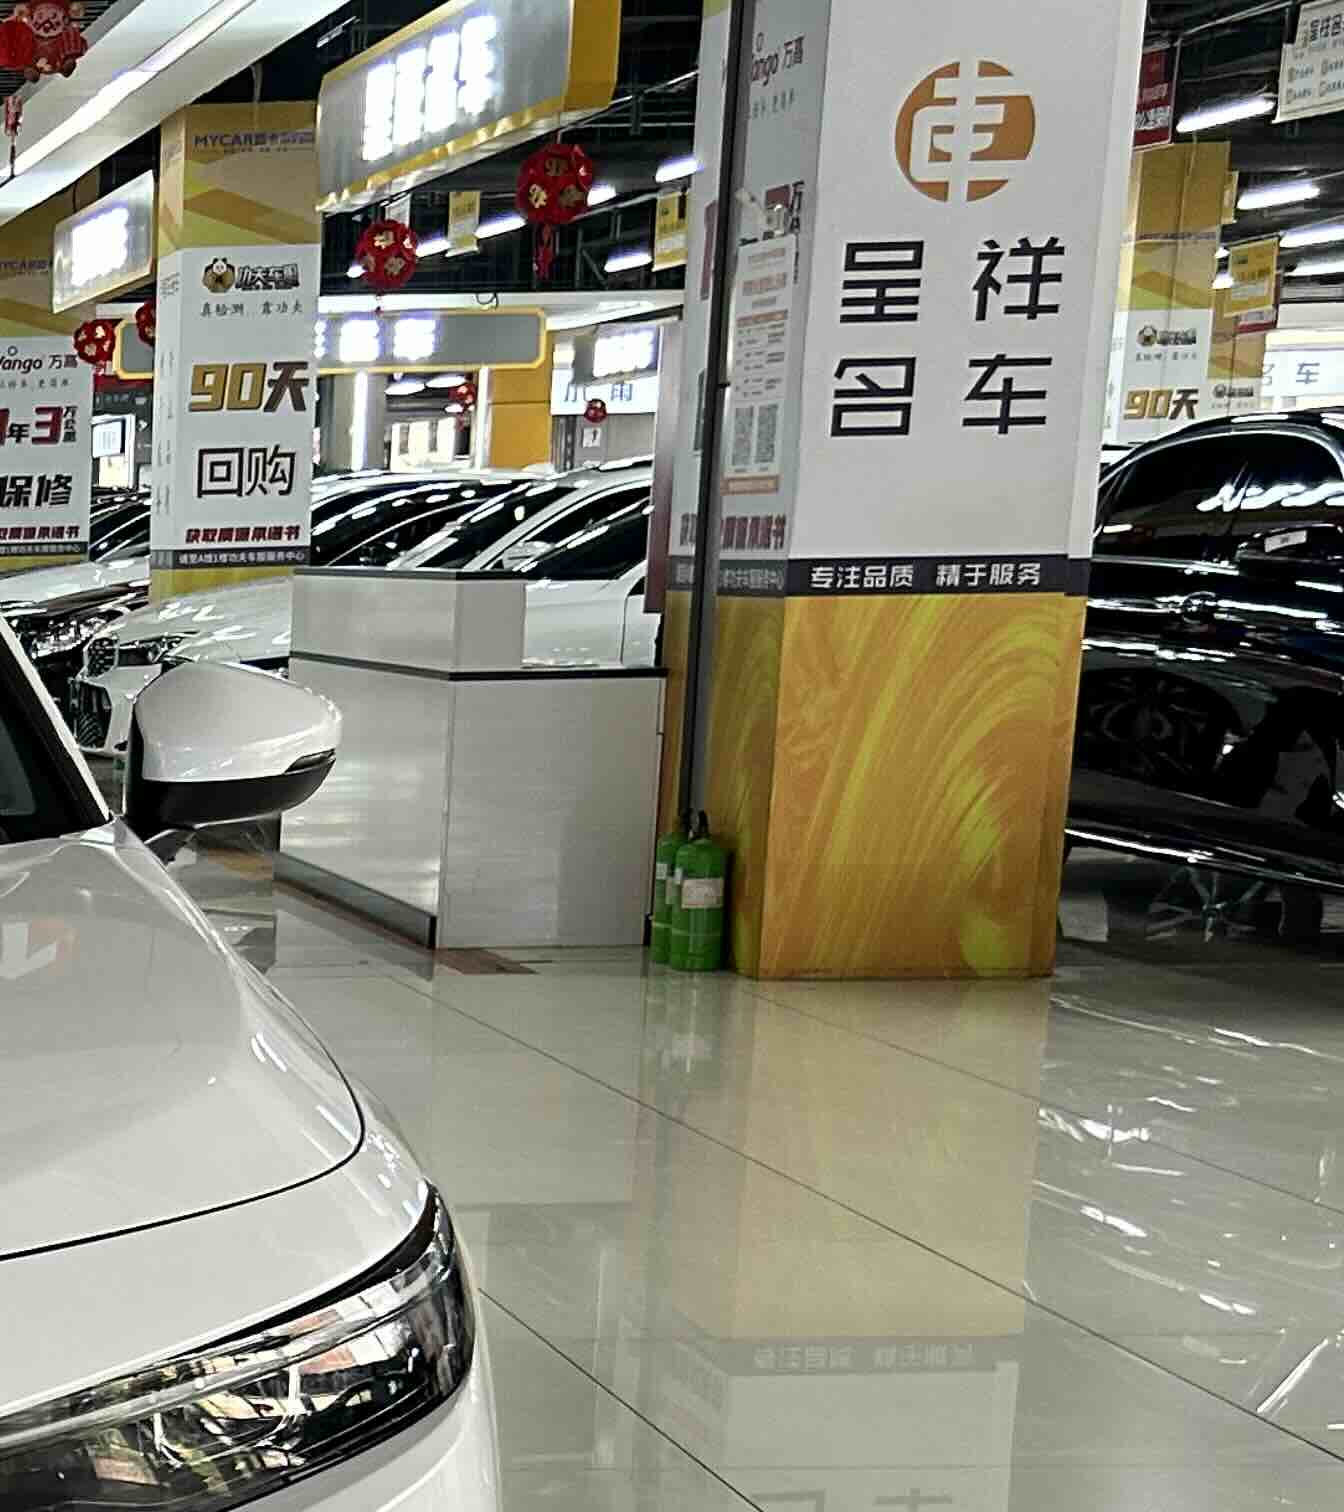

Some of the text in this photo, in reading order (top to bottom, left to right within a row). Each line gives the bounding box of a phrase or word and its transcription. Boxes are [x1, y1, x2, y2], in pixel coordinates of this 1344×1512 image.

[188, 361, 310, 412] 90天
[830, 353, 1053, 437] 名车
[1123, 389, 1199, 420] 90天
[197, 444, 296, 498] 回购
[811, 564, 914, 588] 专注品质
[936, 562, 1041, 587] 精于服务
